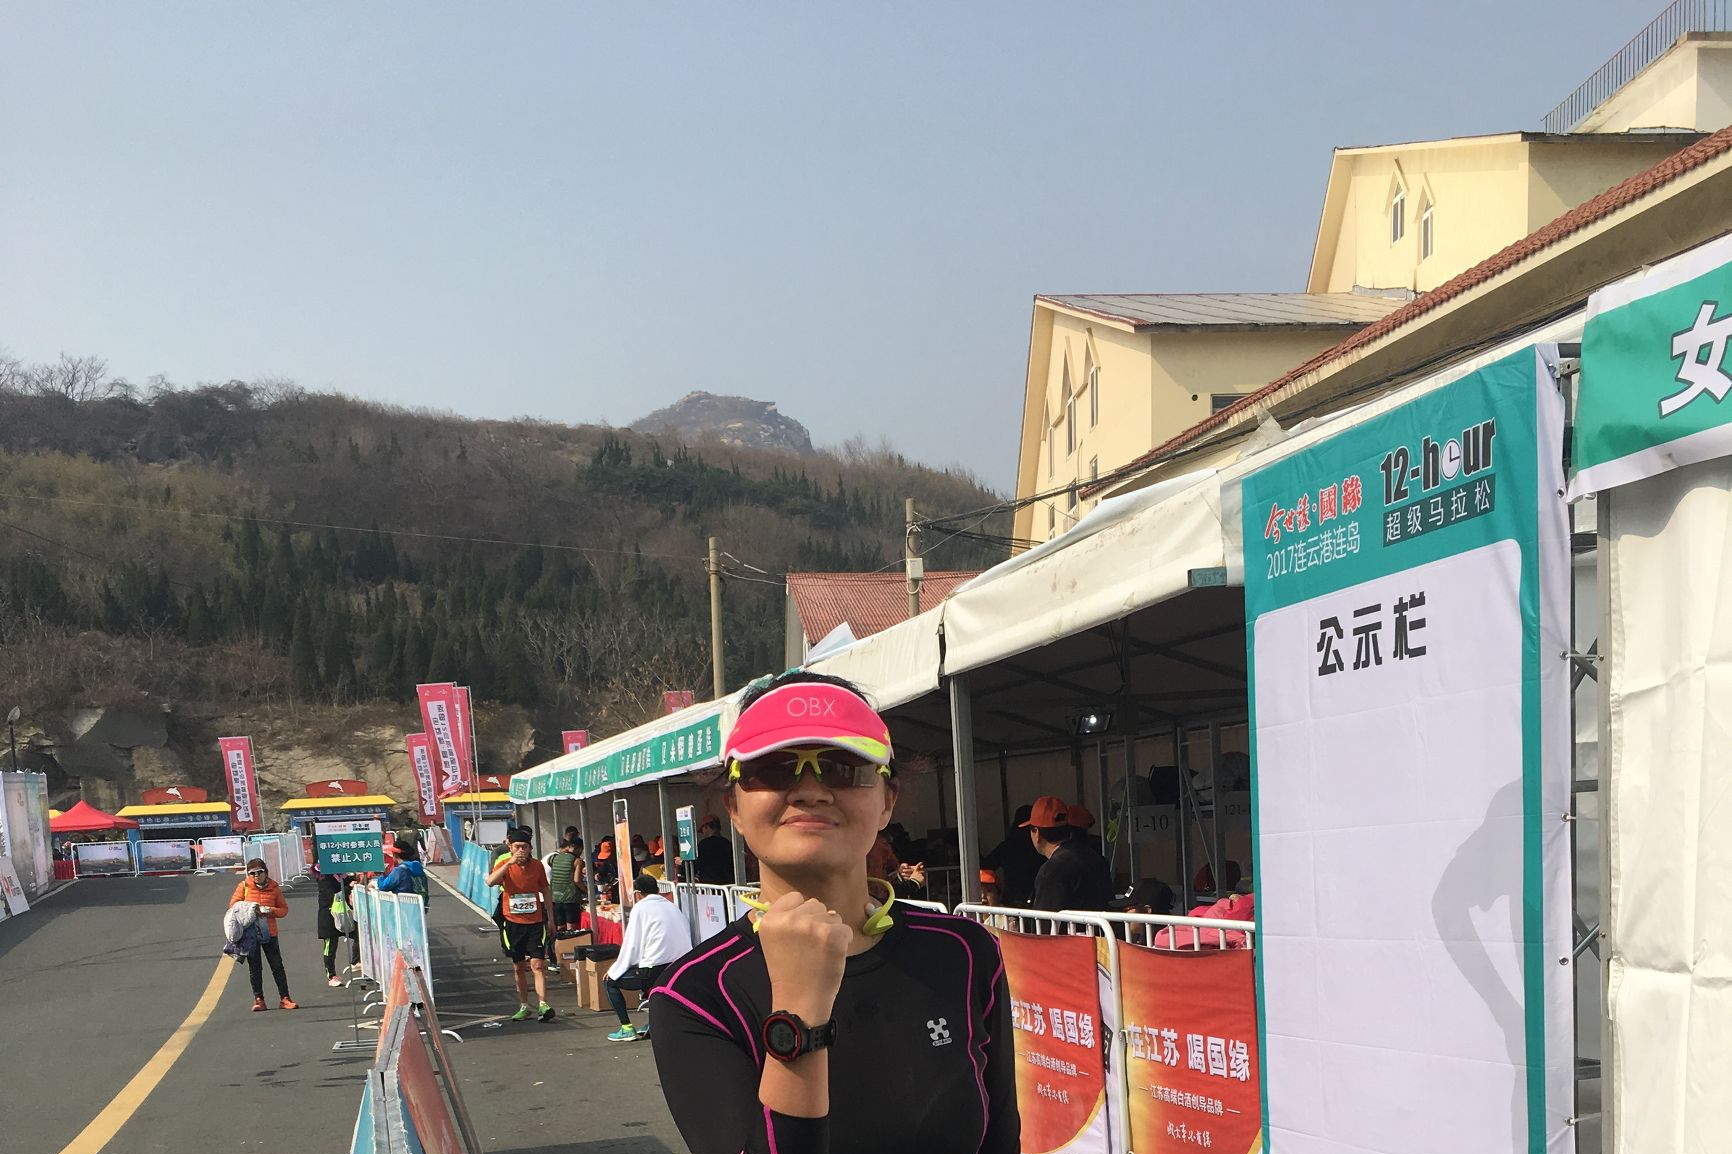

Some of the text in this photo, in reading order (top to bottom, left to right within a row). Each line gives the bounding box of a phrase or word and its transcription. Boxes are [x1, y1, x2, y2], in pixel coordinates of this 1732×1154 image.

[1660, 301, 1732, 419] 女
[1385, 479, 1491, 543] 超级马拉松
[1266, 521, 1361, 580] 2017连云港连岛
[1316, 591, 1427, 677] 公示栏
[787, 697, 837, 717] OBX
[331, 852, 373, 863] 禁止入内
[513, 902, 535, 910] A225
[1127, 1022, 1250, 1082] 在江苏 喝国缘
